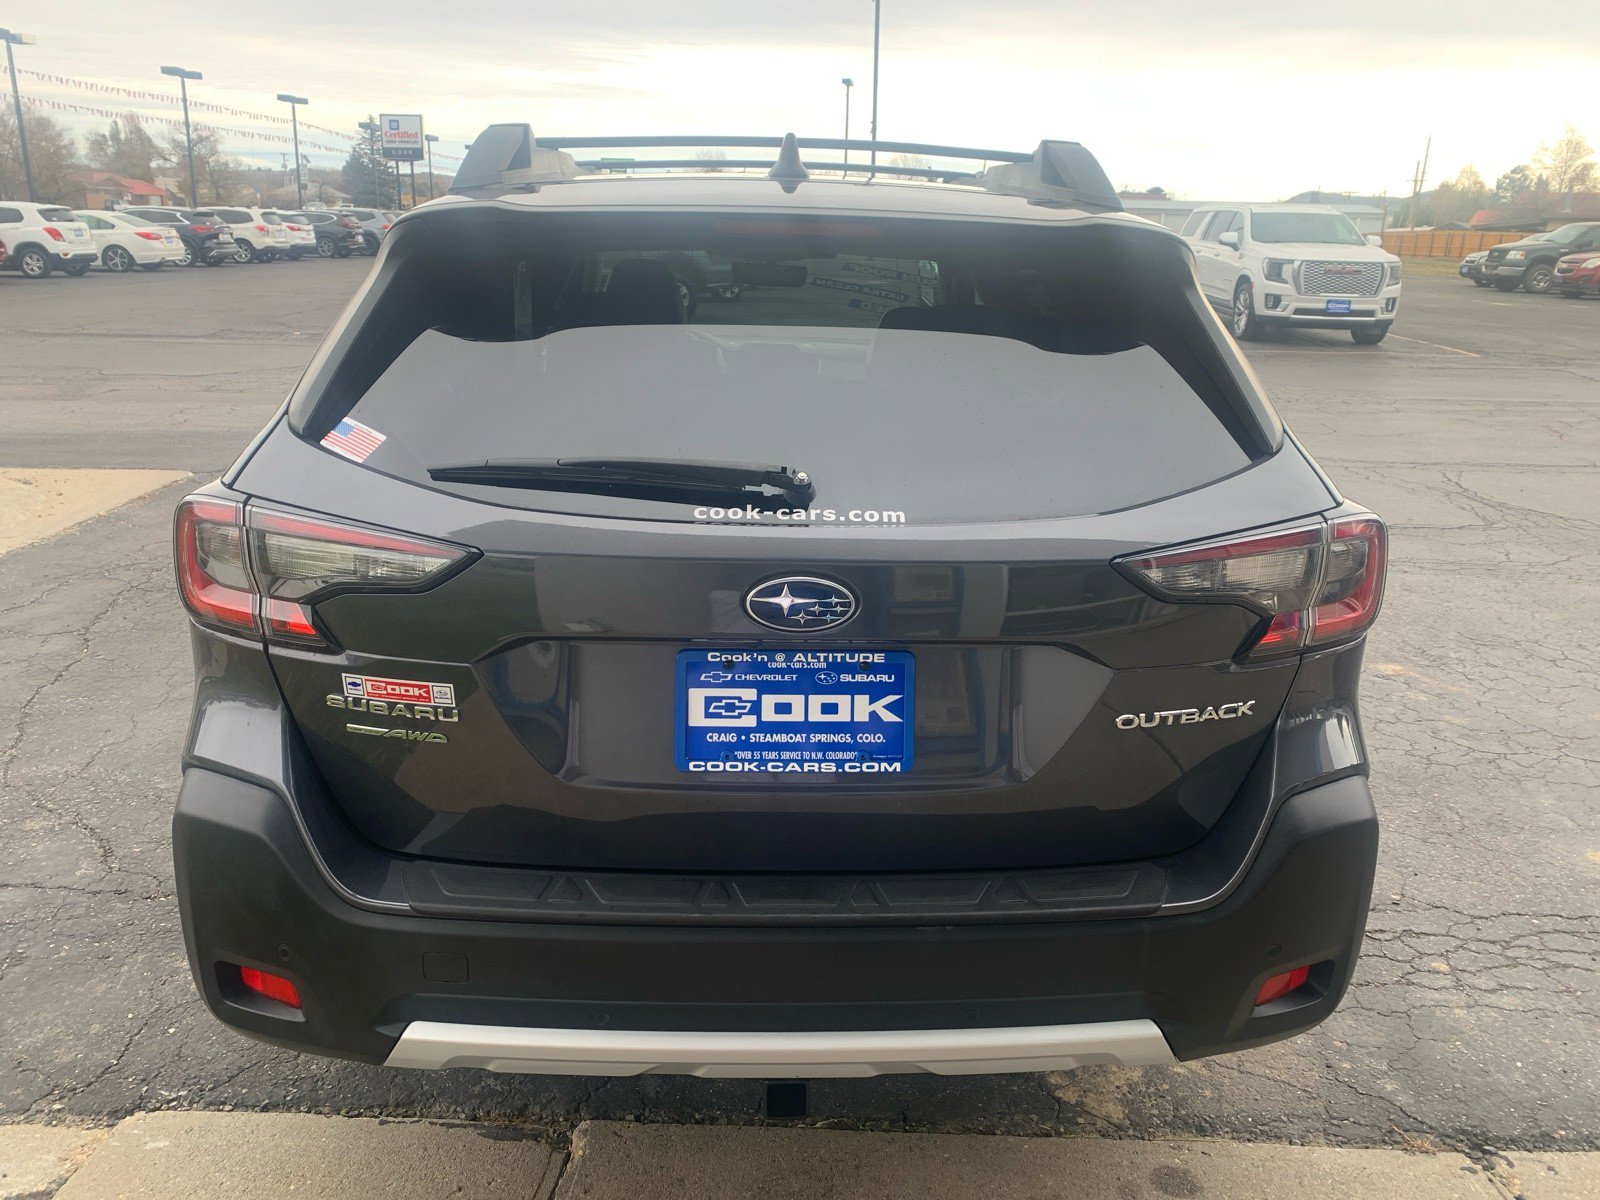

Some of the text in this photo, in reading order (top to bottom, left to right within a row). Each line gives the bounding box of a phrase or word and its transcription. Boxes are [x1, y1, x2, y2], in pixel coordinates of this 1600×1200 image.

[384, 130, 418, 139] Certified
[693, 504, 906, 523] cook-cars.com
[707, 652, 885, 663] Cook'n @ ALTITUDE
[767, 661, 827, 669] cook-cars.com
[734, 673, 798, 681] CHEVROLET
[839, 673, 895, 683] SUBARU
[365, 680, 429, 697] COOK
[325, 694, 459, 722] SUBARU
[688, 688, 904, 727] COOK
[1115, 700, 1256, 730] OUTBACK
[383, 729, 448, 743] AWD
[706, 732, 886, 744] CRAIG STEAMBOAT SPRINGS, COLO.
[734, 750, 858, 760] "OVER 55 YEARS SERVICE TO N.W. COLORADO"
[688, 761, 901, 773] COOK-CARS.COM
